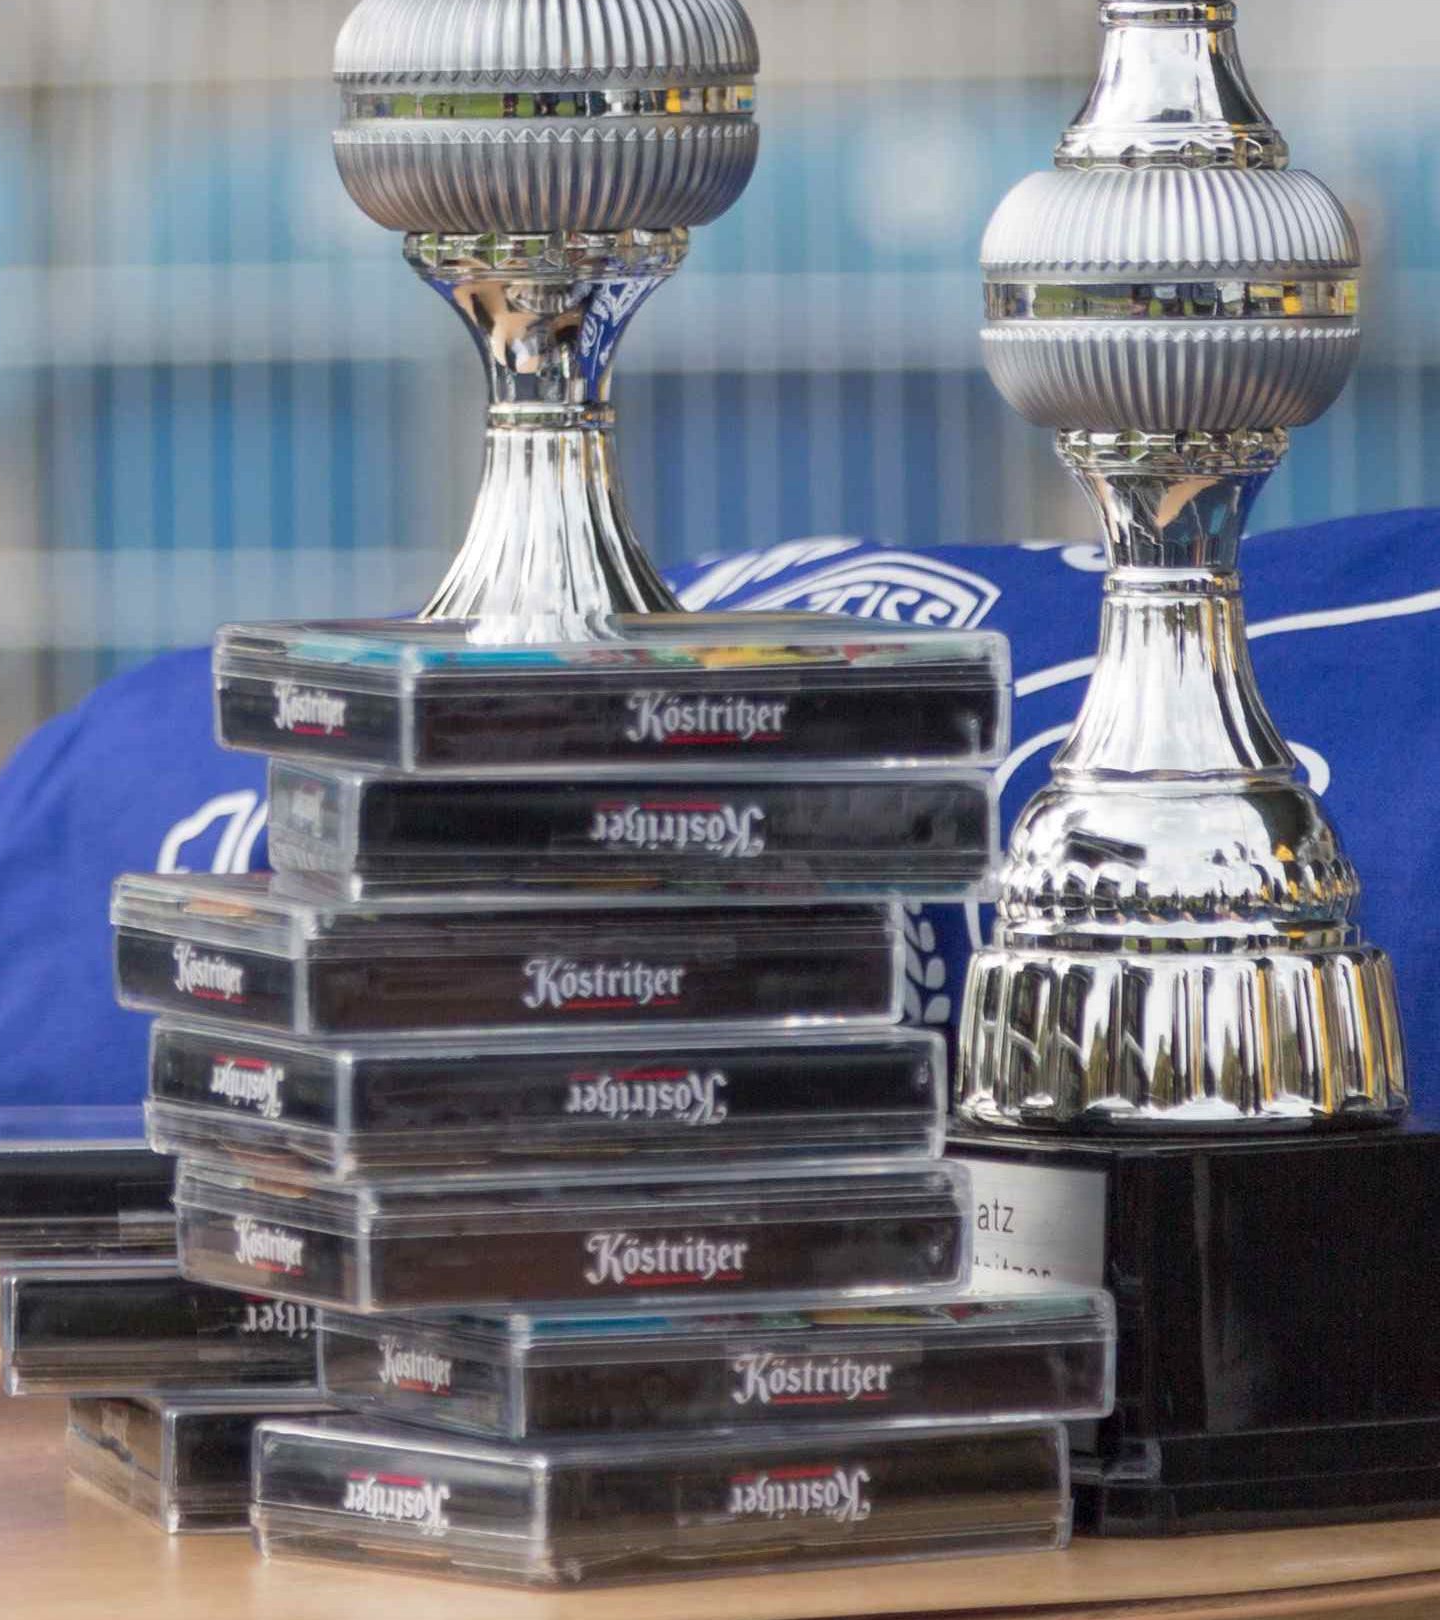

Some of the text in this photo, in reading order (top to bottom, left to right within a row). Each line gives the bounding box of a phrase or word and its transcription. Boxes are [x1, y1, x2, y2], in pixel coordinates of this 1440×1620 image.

[625, 688, 787, 742] Köstritzer
[590, 802, 765, 858] Köstritzer
[522, 957, 687, 1009] Köstritzer
[565, 1069, 728, 1126] Köstritzer
[977, 1198, 1014, 1233] atz
[584, 1232, 749, 1285] Köstritzer
[731, 1352, 893, 1405] Köstritzer
[729, 1468, 871, 1523] Köstritzer
